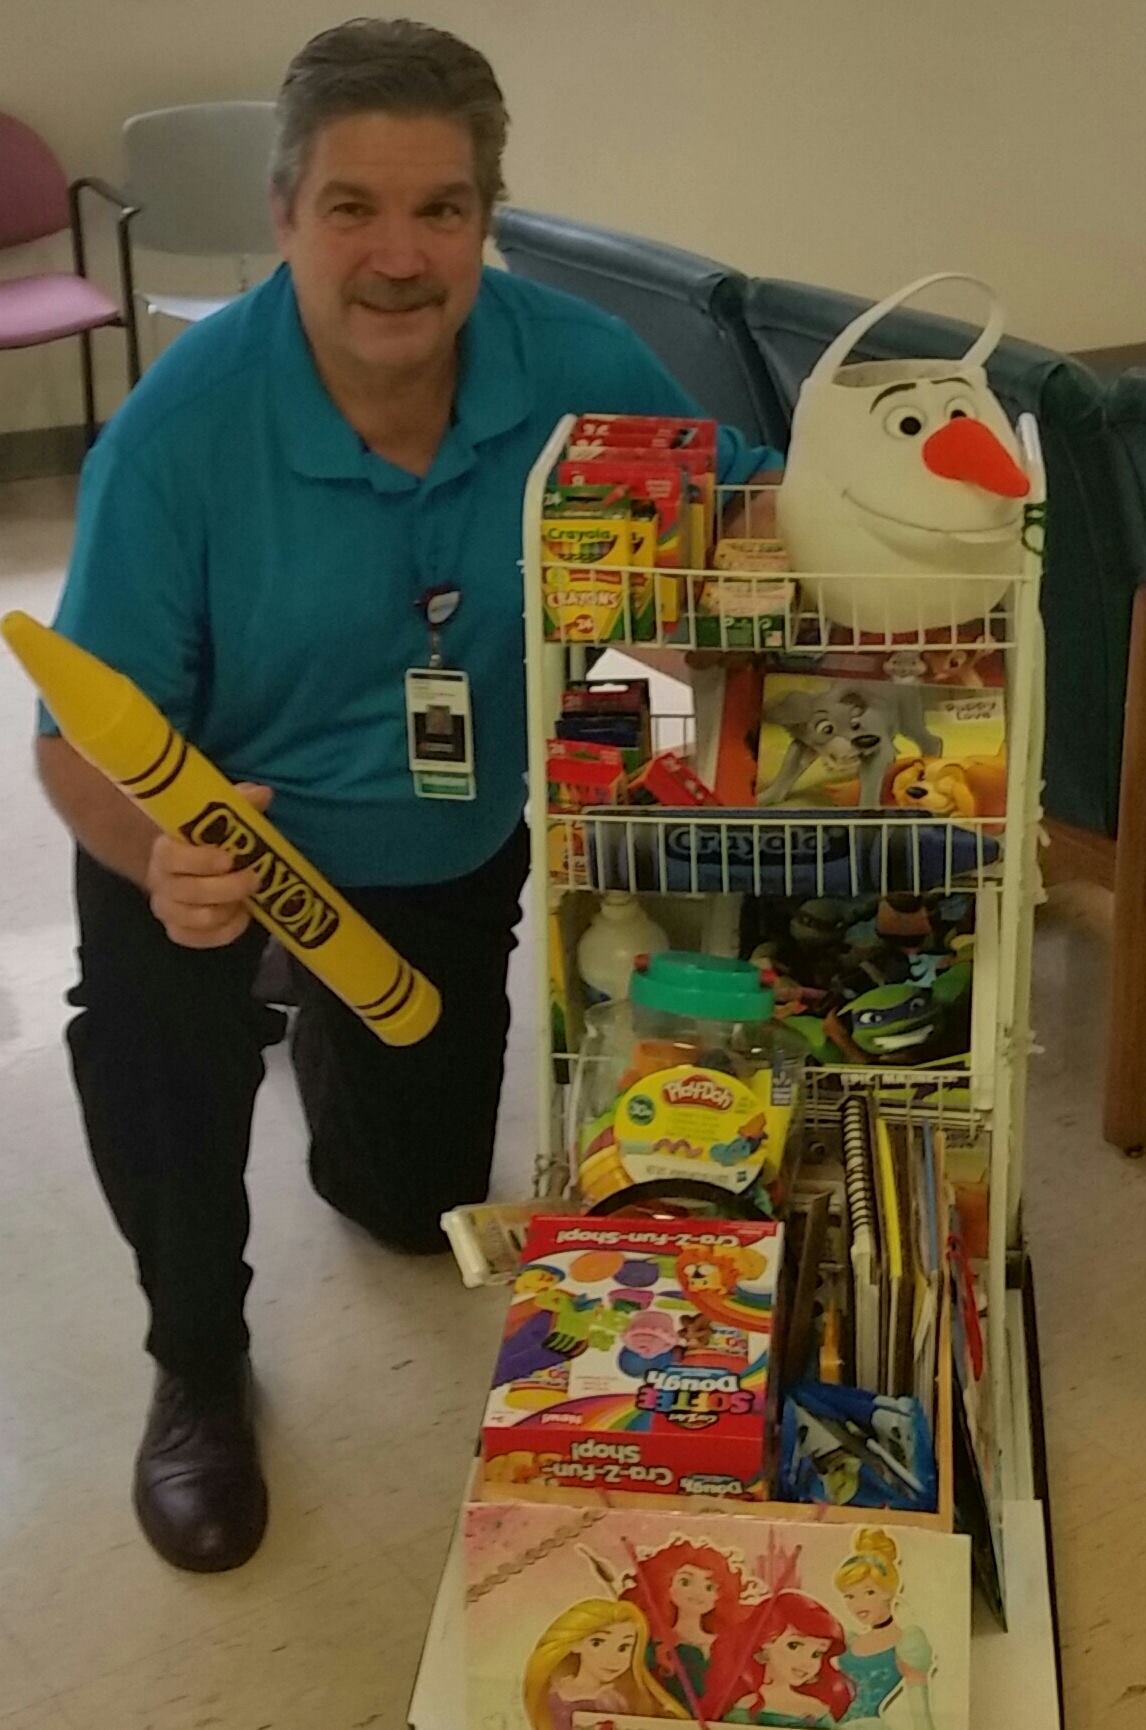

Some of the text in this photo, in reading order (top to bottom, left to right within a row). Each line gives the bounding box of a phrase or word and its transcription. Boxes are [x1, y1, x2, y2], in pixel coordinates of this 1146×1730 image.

[547, 527, 611, 542] Crayola
[667, 825, 832, 860] Crayola
[190, 807, 338, 943] CRAYON
[663, 1080, 734, 1109] Play-Doh
[637, 1385, 754, 1414] SOFTEE
[572, 1439, 641, 1464] Shop!
